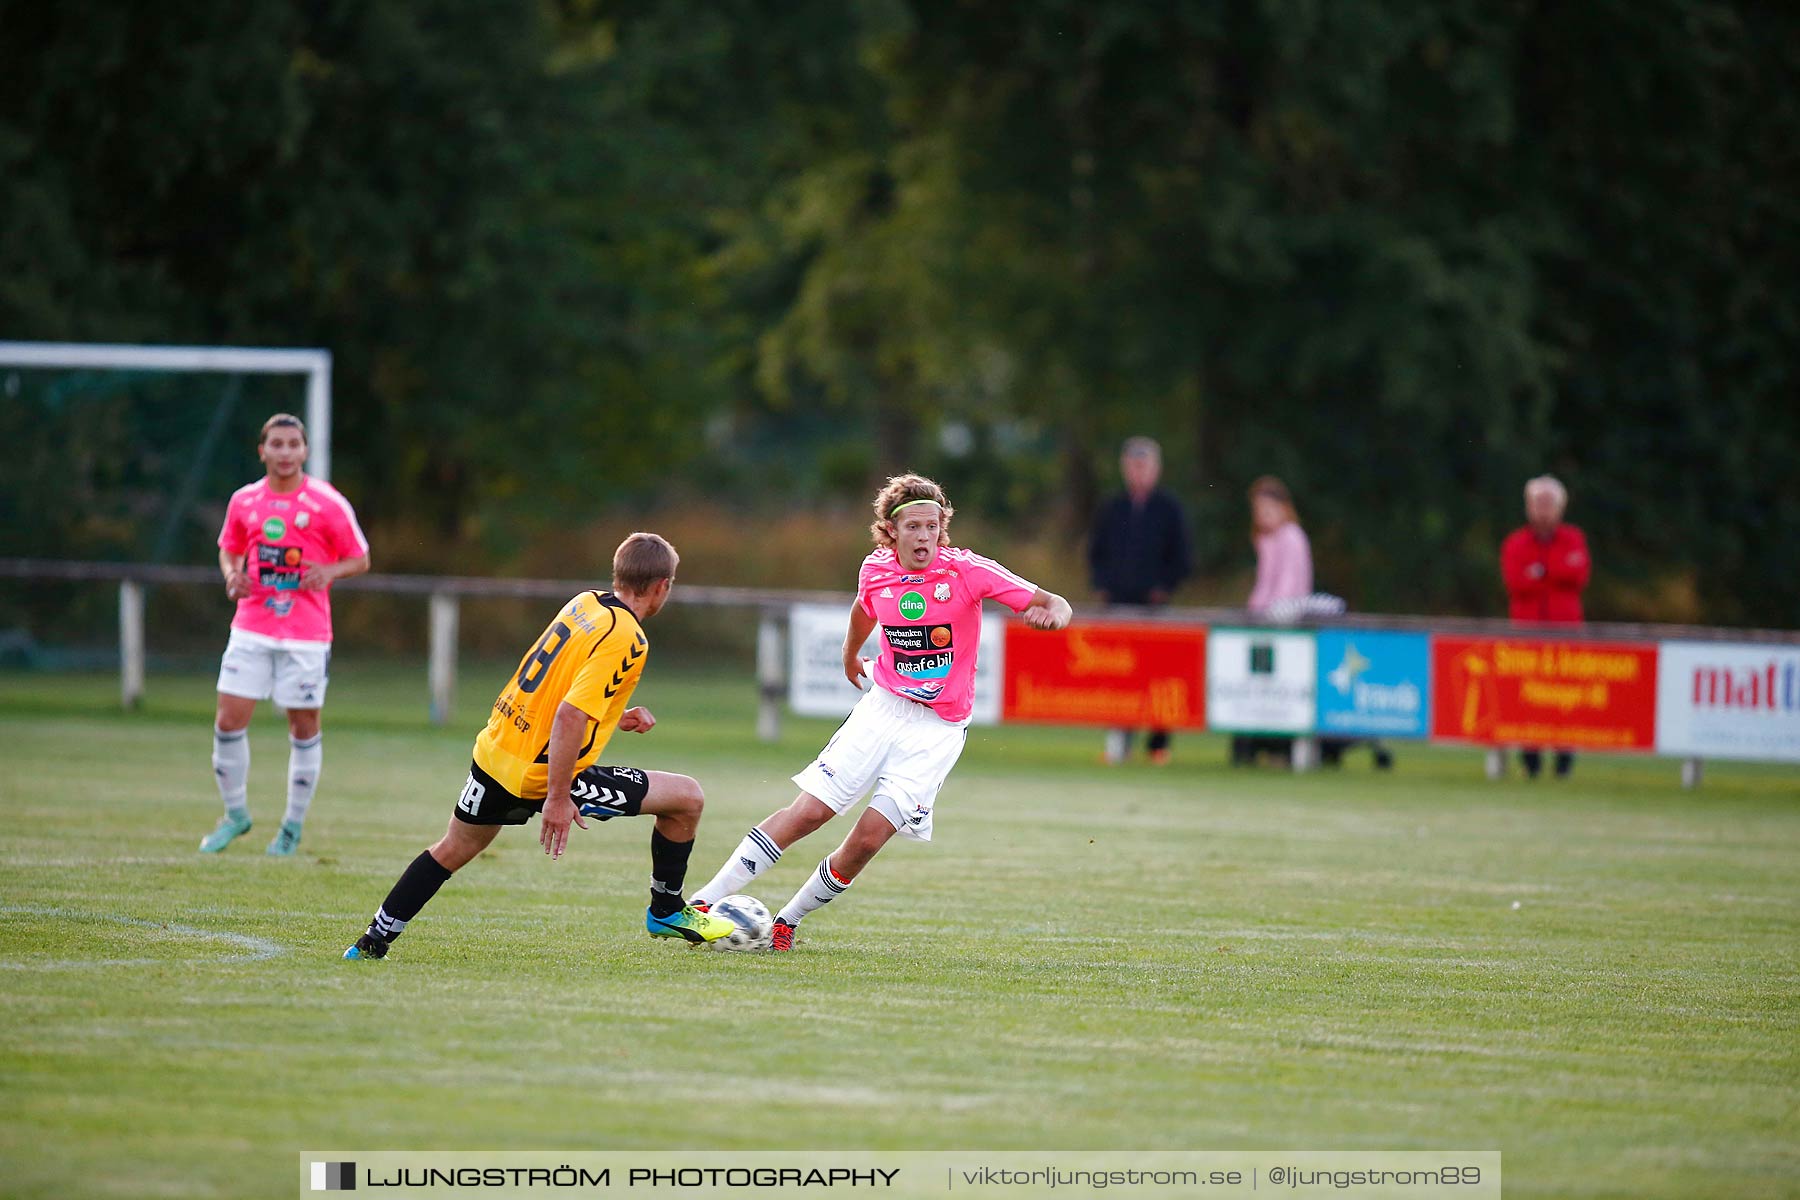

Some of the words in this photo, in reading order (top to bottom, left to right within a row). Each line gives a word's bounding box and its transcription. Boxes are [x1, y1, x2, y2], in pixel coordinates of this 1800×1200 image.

[901, 600, 924, 610] dina
[884, 627, 923, 638] Sparbanken
[518, 621, 571, 693] 8
[896, 657, 926, 674] gustaf
[936, 651, 952, 668] bil
[514, 715, 530, 733] CUP
